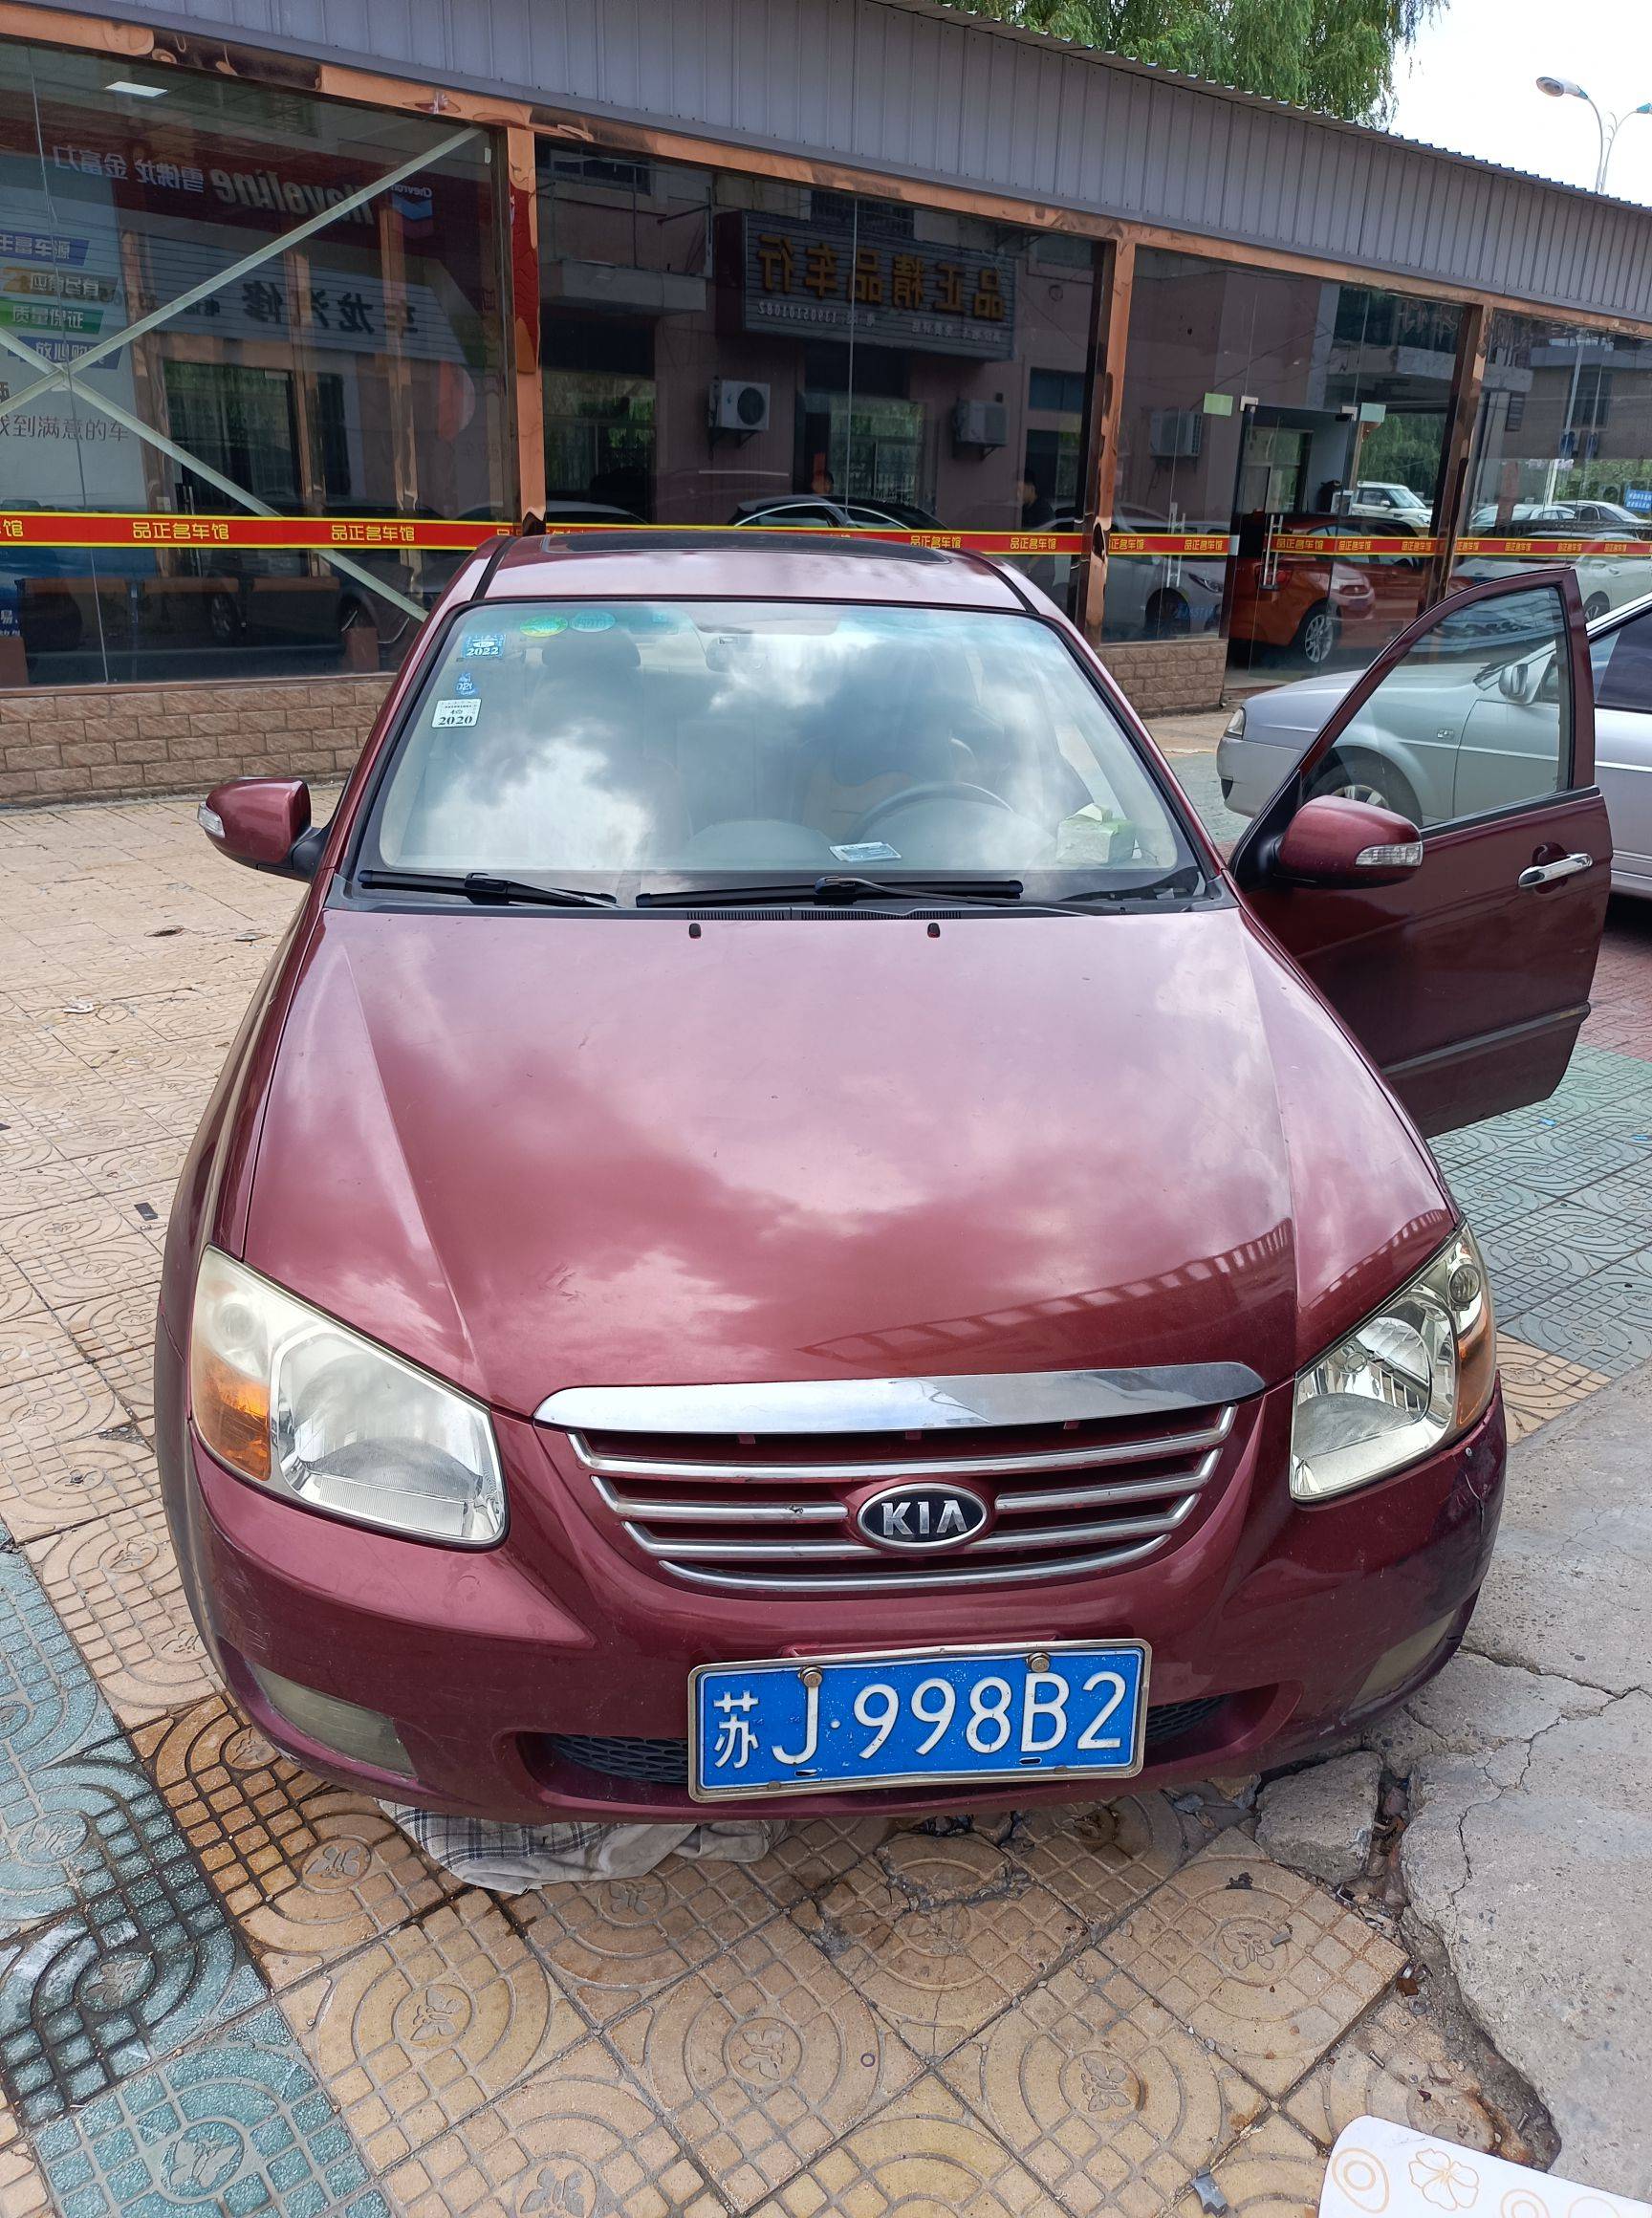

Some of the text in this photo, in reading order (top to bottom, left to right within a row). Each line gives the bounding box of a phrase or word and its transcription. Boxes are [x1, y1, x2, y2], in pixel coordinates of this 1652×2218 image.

[12, 305, 83, 329] 质量保证
[0, 519, 23, 537] 馆
[132, 521, 229, 540] 品正名车馆
[331, 525, 415, 541] 品正名车馆
[1010, 536, 1056, 550] 品正名车馆
[1109, 538, 1144, 551] 正名车馆
[466, 645, 499, 657] 2022
[438, 715, 473, 726] 2020
[881, 1499, 968, 1536] KIA
